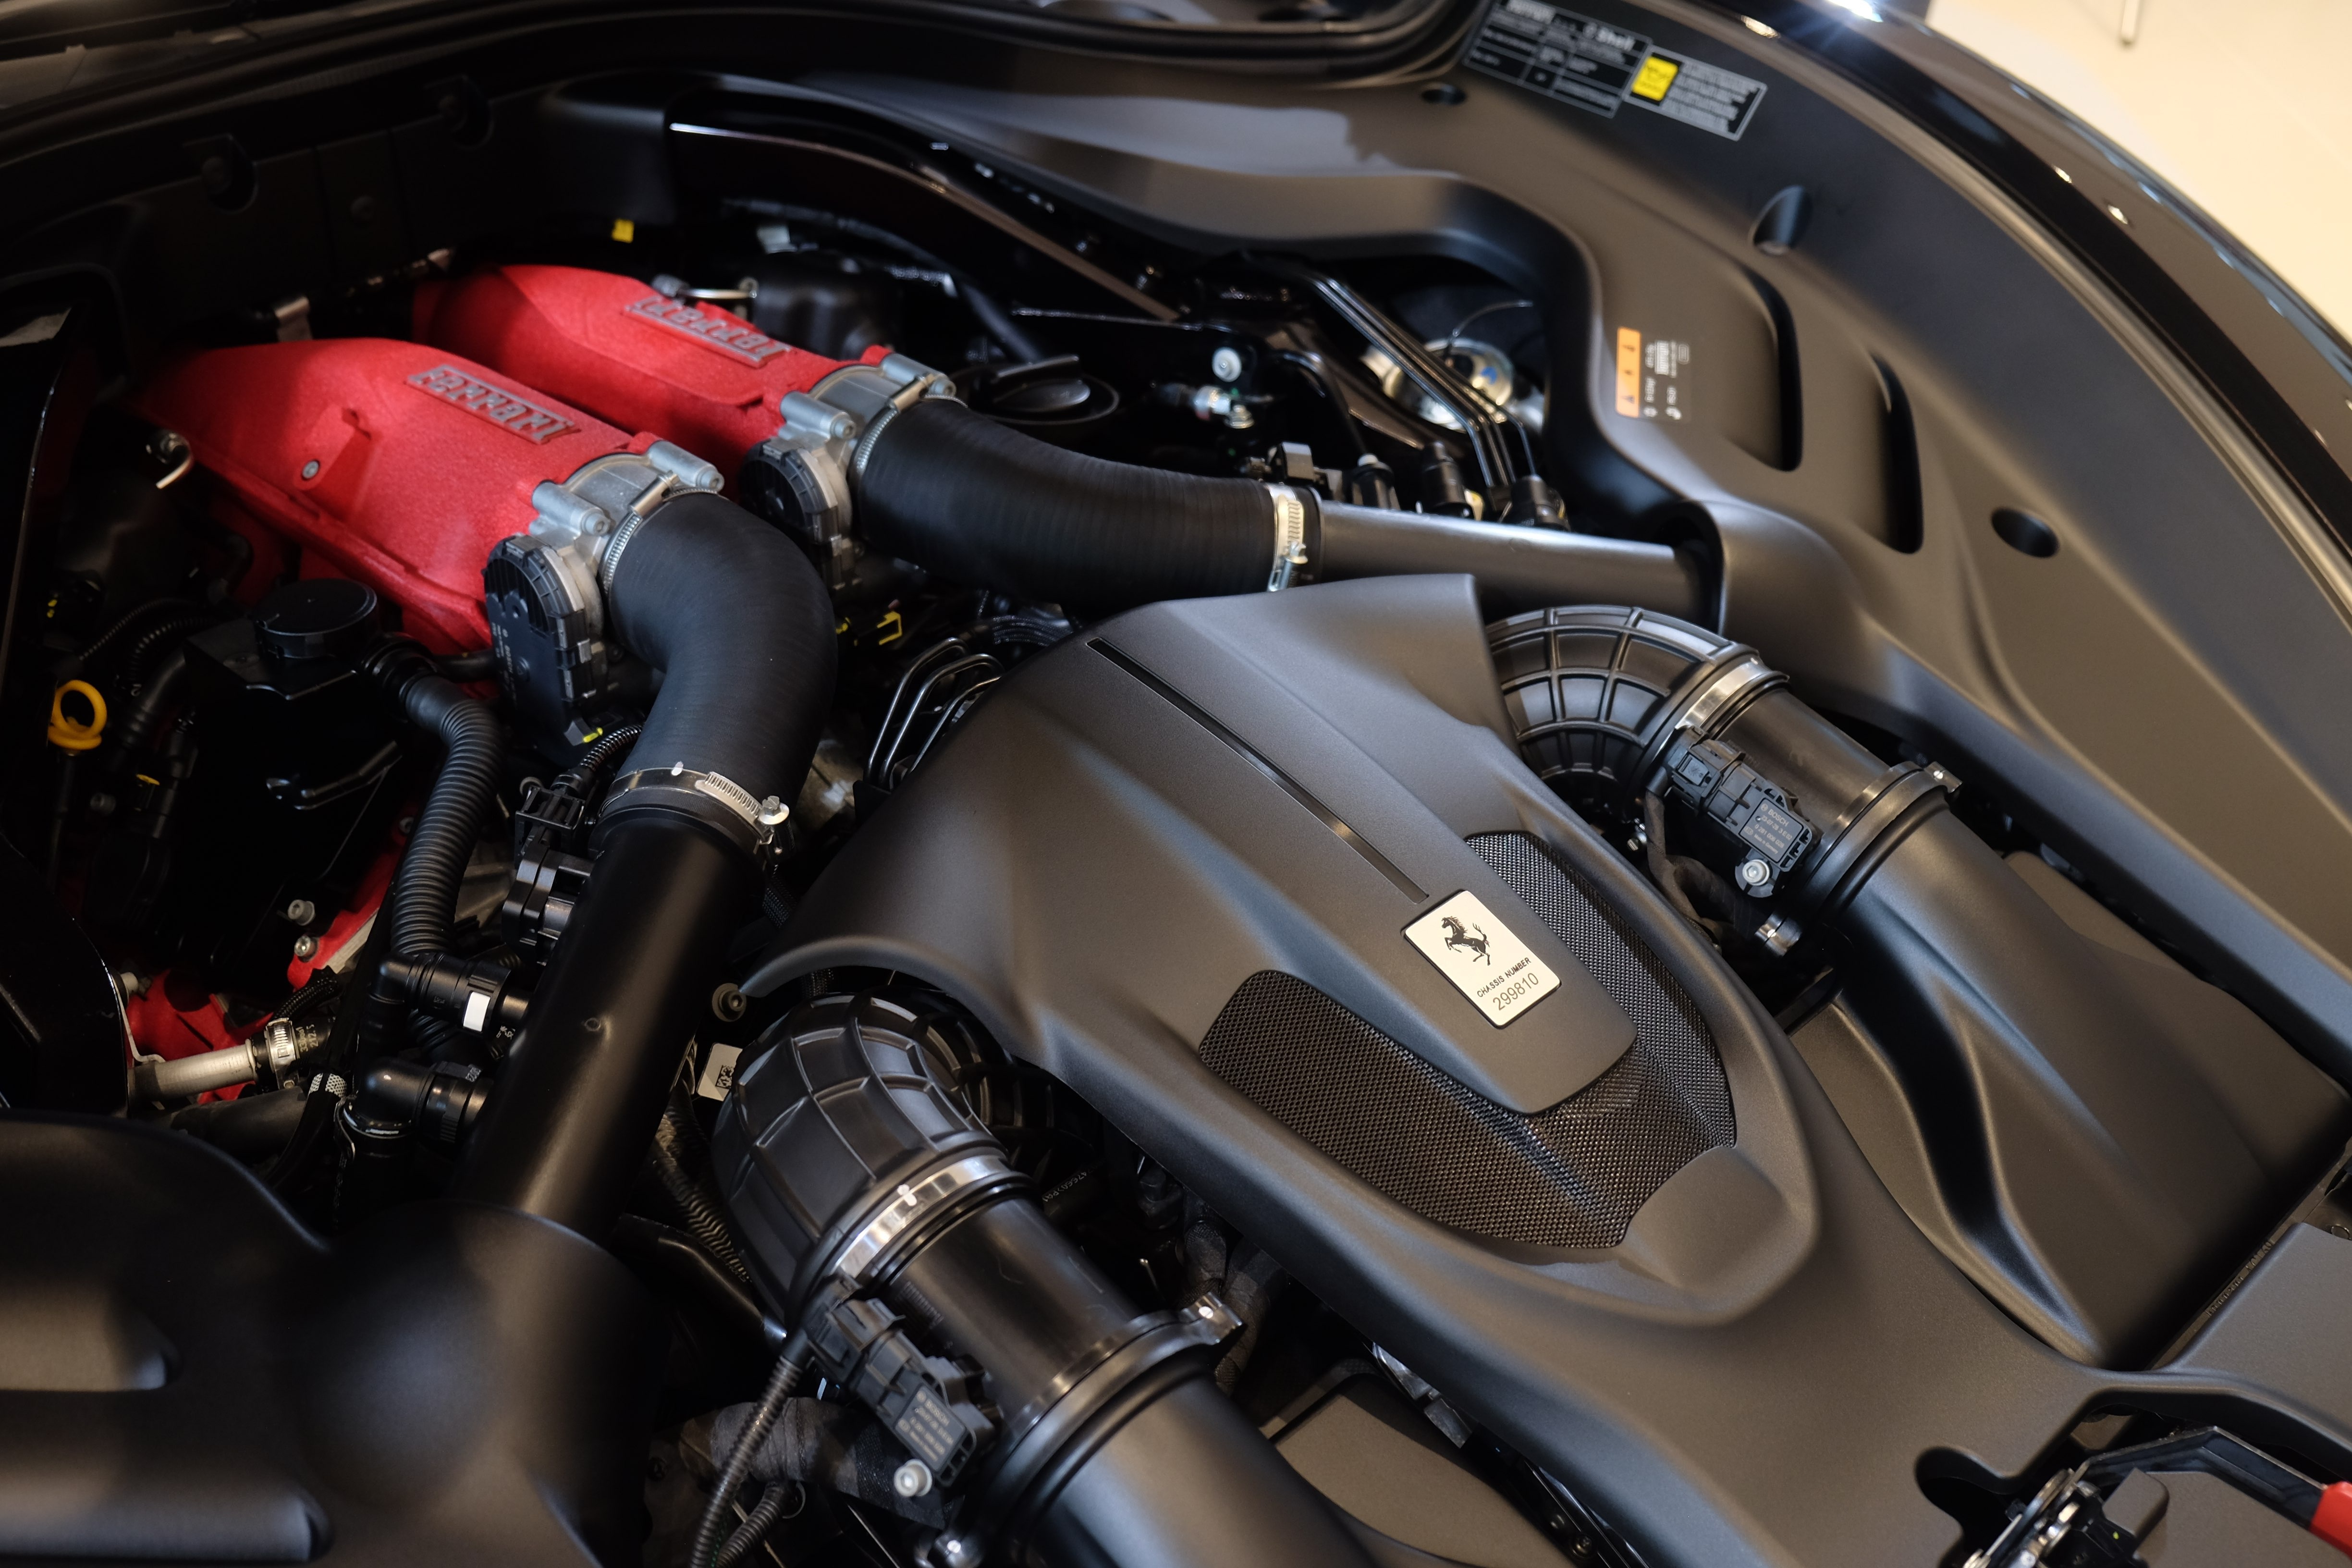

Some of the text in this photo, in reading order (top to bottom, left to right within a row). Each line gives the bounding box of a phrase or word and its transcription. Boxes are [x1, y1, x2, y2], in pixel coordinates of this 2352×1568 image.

[1768, 809, 1788, 826] BOSCH
[1477, 957, 1531, 997] CHASSIS NUMBER
[1493, 973, 1539, 1011] 299810
